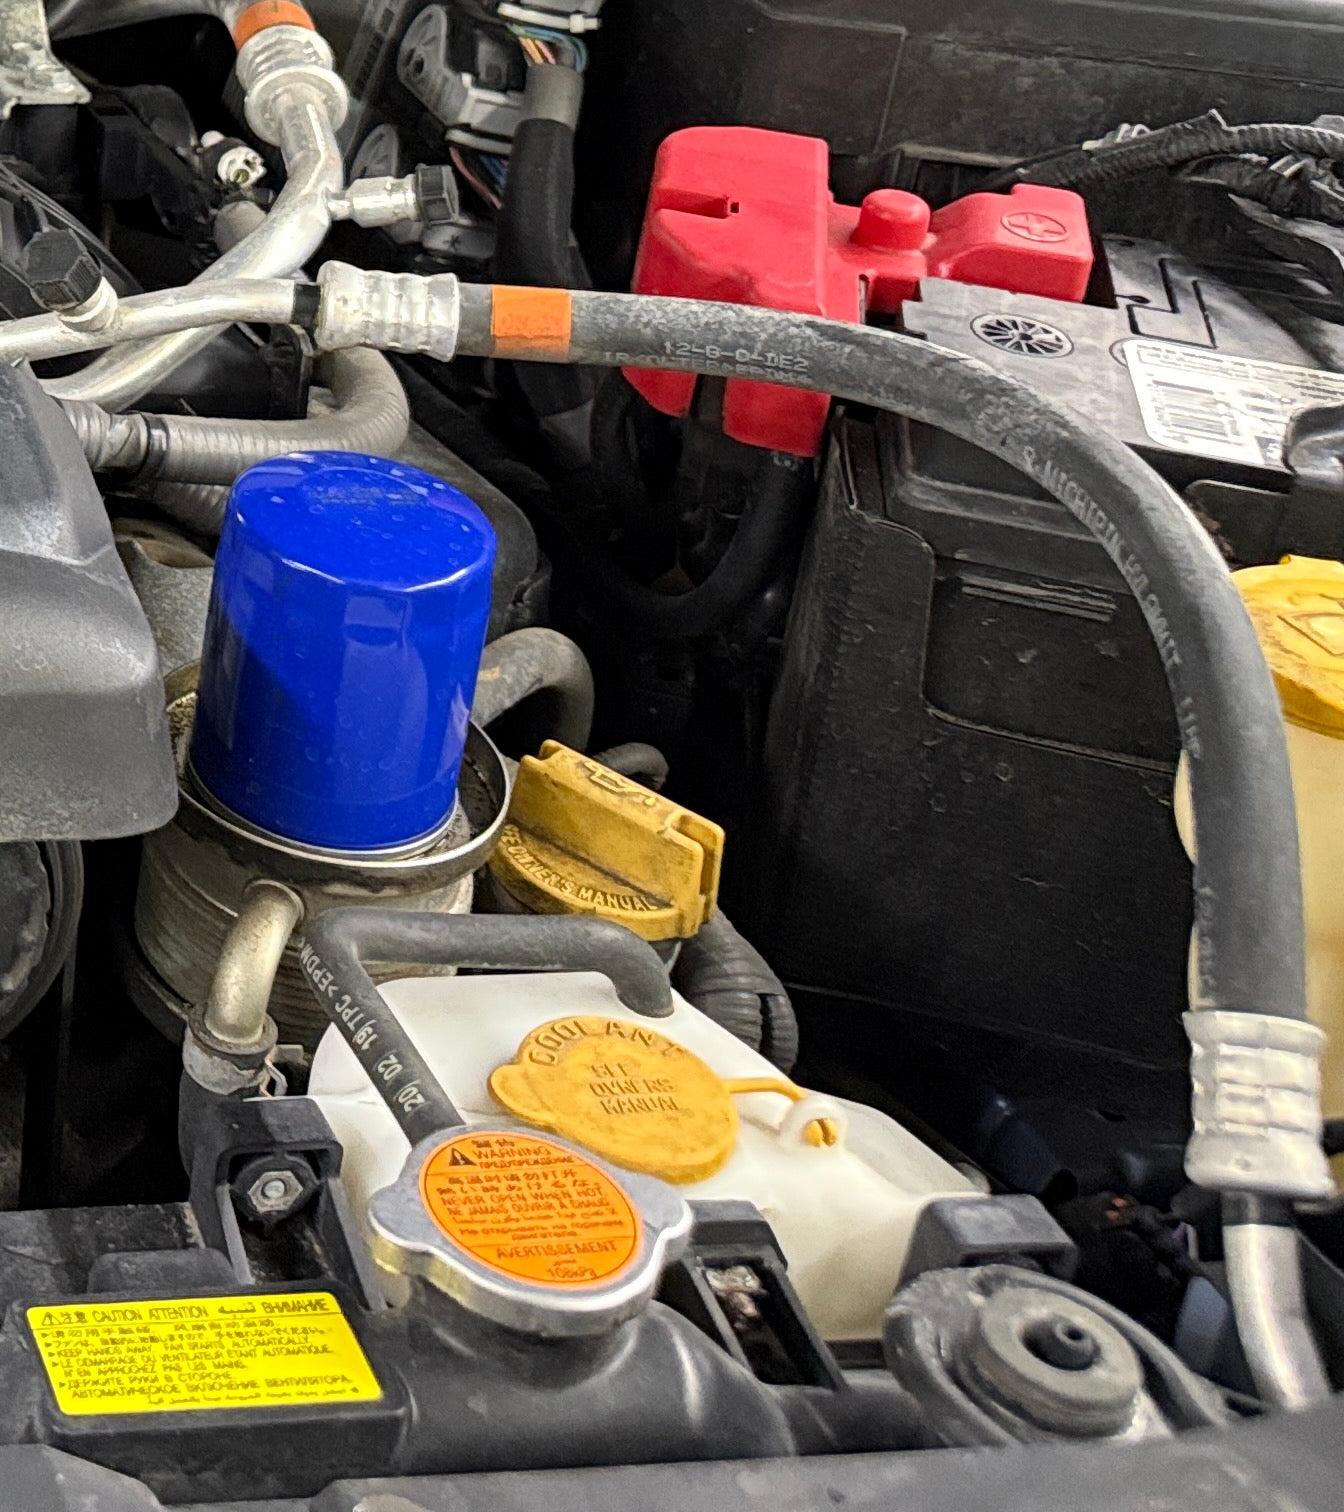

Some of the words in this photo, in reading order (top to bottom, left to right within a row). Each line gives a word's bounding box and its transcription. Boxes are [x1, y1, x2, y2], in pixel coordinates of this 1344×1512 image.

[578, 886, 658, 912] MANUAL
[528, 1020, 689, 1066] COOLANT
[473, 1146, 551, 1159] WARNING
[442, 1194, 485, 1206] NEVER
[489, 1192, 527, 1203] OPEN
[532, 1189, 572, 1201] WHEN
[496, 1240, 617, 1259] AVERTISSEMENT
[92, 1308, 142, 1322] CAUTION
[147, 1305, 208, 1320] ATTENTION
[262, 1298, 329, 1313] ВНИМАНИЕ
[87, 1346, 121, 1355] HANDS
[161, 1351, 224, 1362] VENTILATEUR
